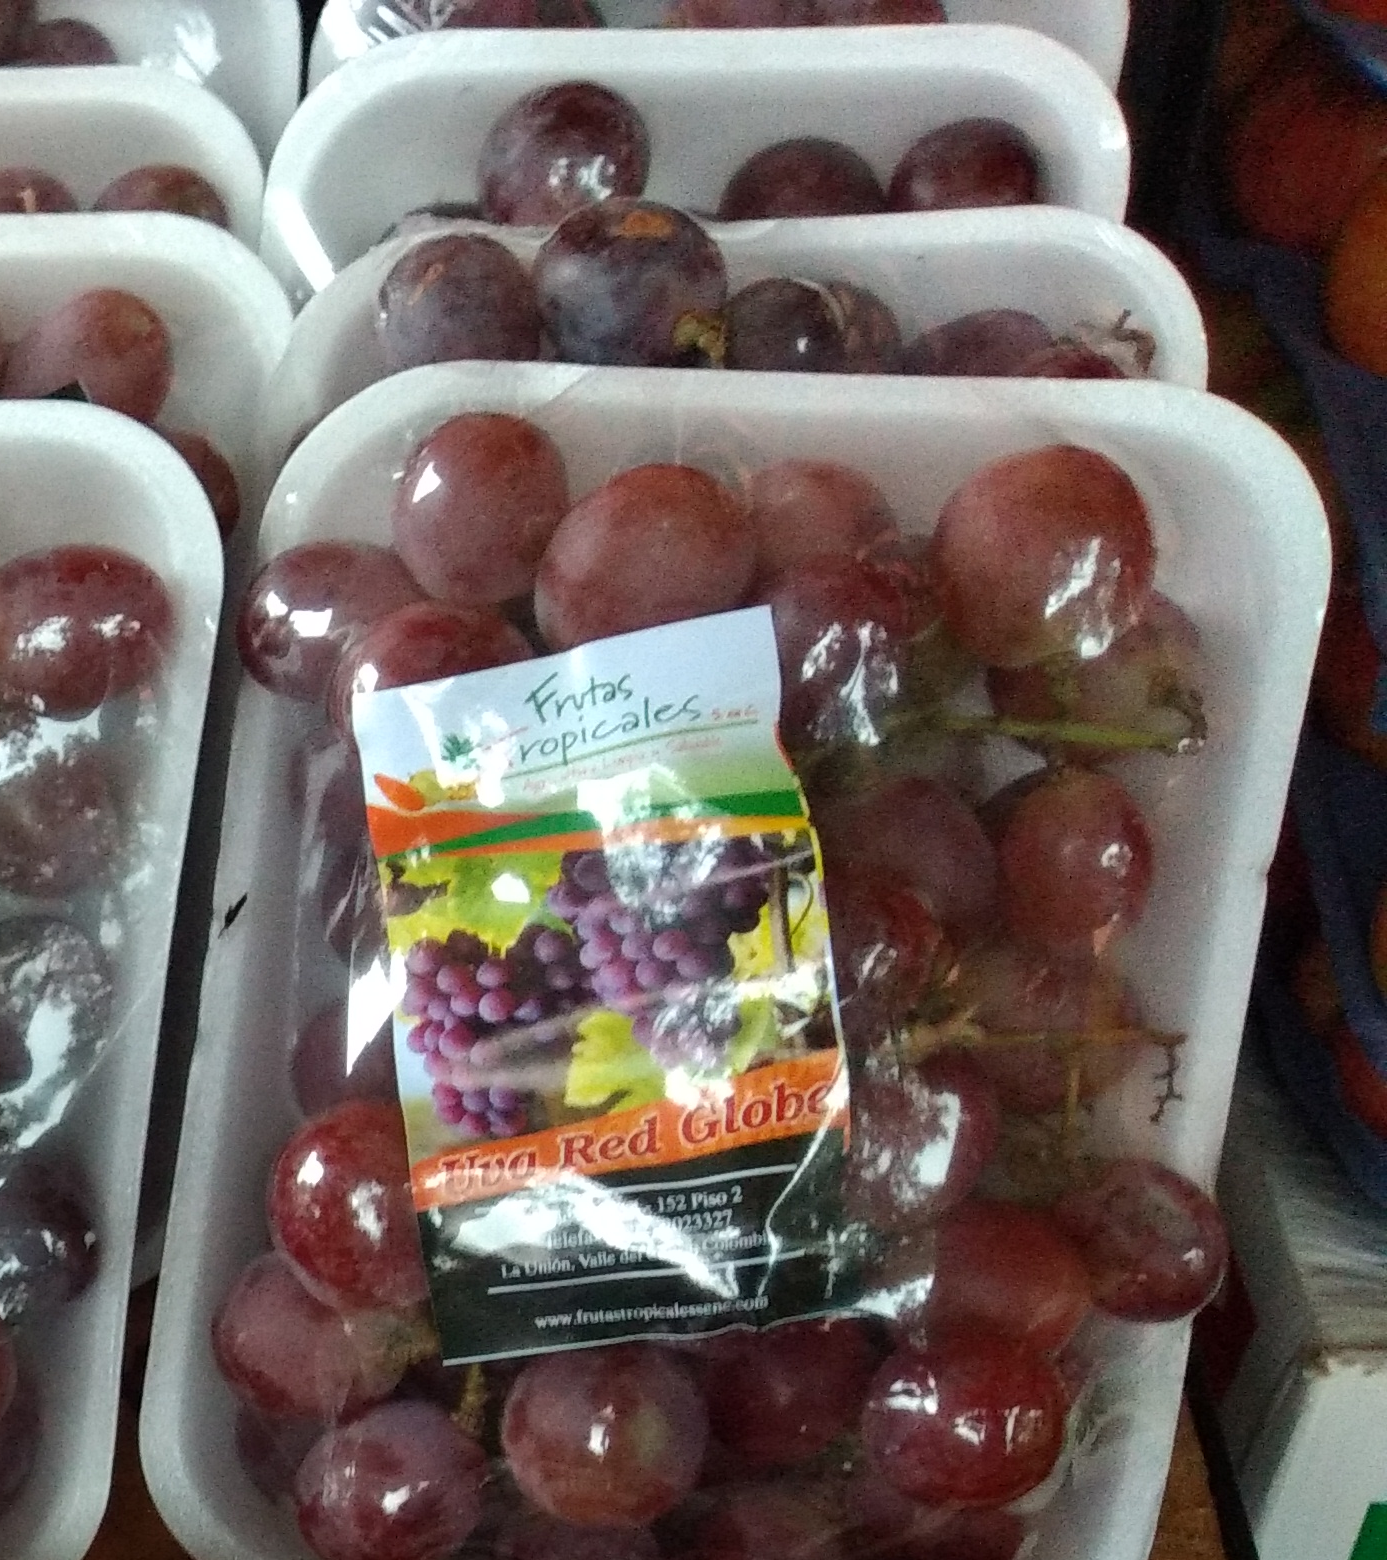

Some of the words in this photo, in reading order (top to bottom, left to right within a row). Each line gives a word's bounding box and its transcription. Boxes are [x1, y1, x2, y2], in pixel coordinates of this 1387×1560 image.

[525, 672, 633, 723] Frutas
[484, 694, 701, 766] ropicales
[562, 1116, 663, 1168] Red
[657, 1195, 687, 1214] 152
[691, 1191, 728, 1210] Piso
[730, 1185, 744, 1205] 2
[668, 1207, 734, 1233] 023327
[701, 1229, 773, 1252] Colombi
